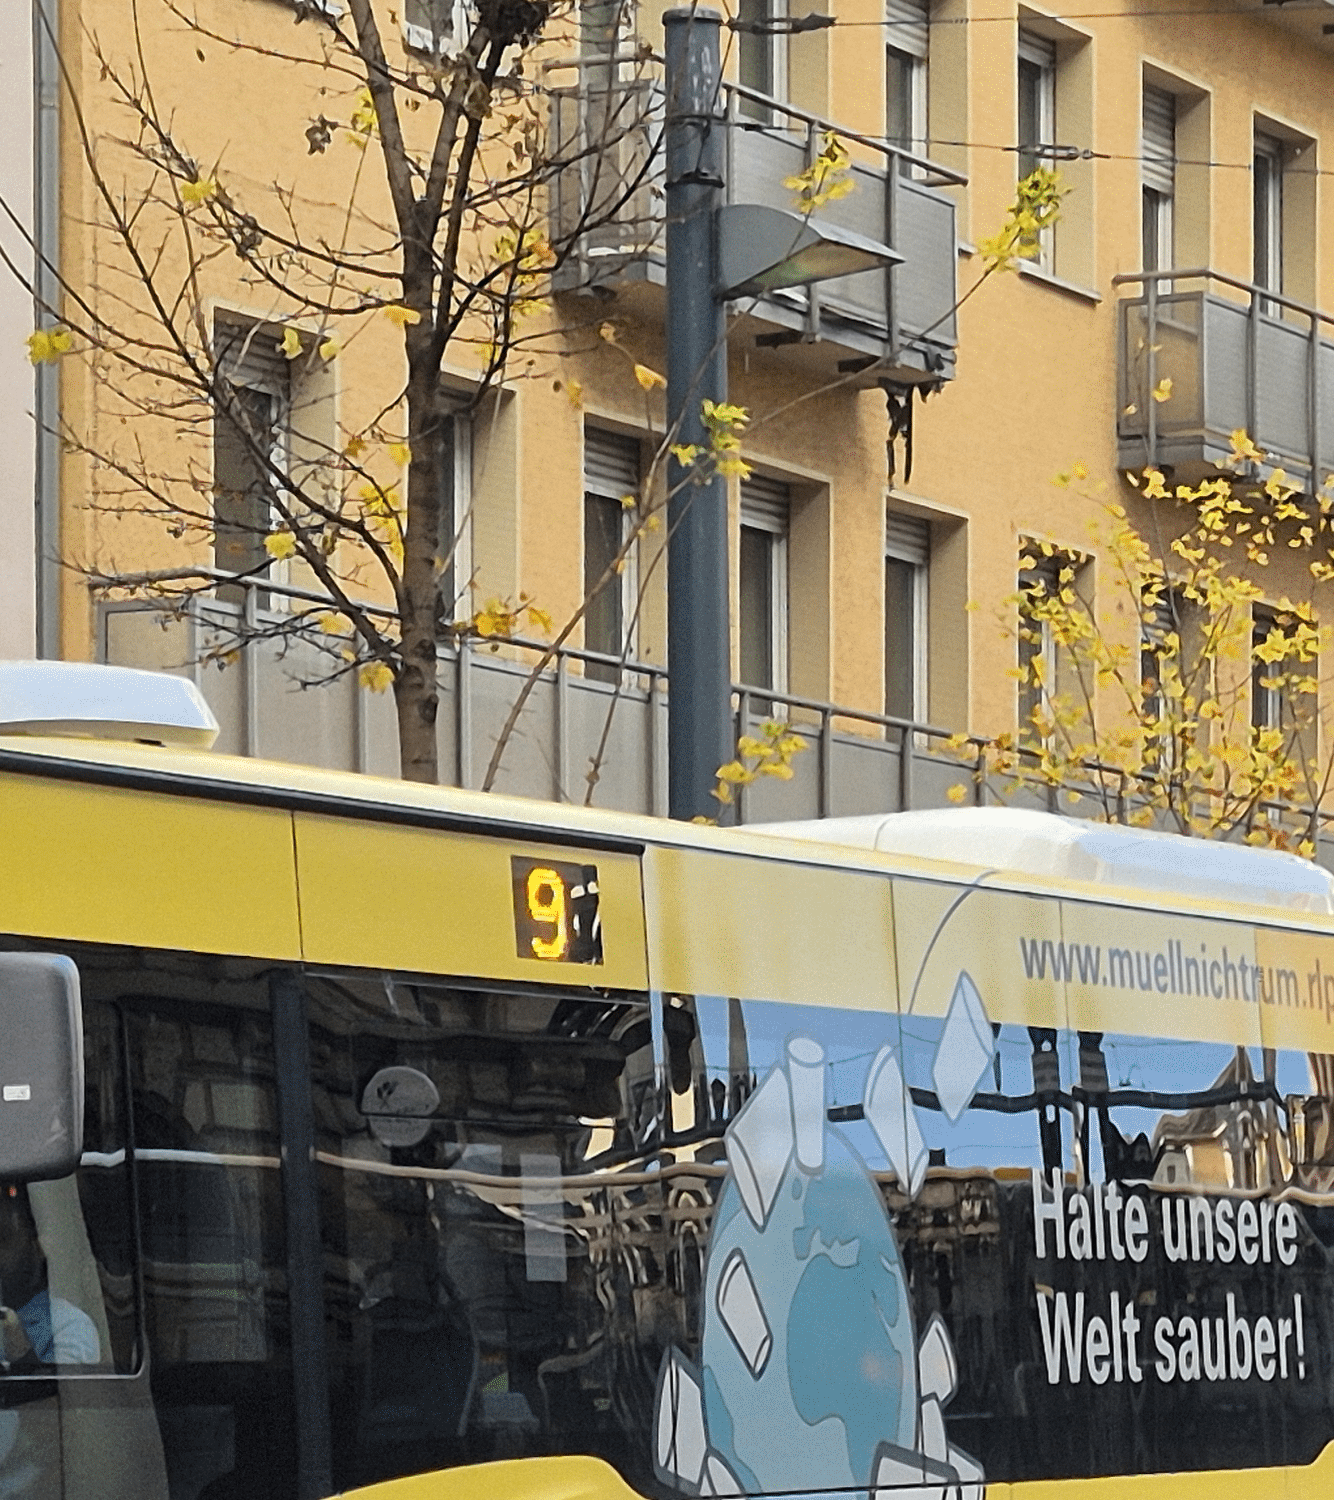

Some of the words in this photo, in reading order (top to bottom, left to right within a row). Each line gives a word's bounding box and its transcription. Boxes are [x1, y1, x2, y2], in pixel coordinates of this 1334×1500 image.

[526, 867, 567, 958] 9
[1030, 1166, 1149, 1263] Halte
[1161, 1195, 1299, 1267] unsere
[1035, 1290, 1144, 1386] Welt
[1154, 1291, 1306, 1384] sauber!
